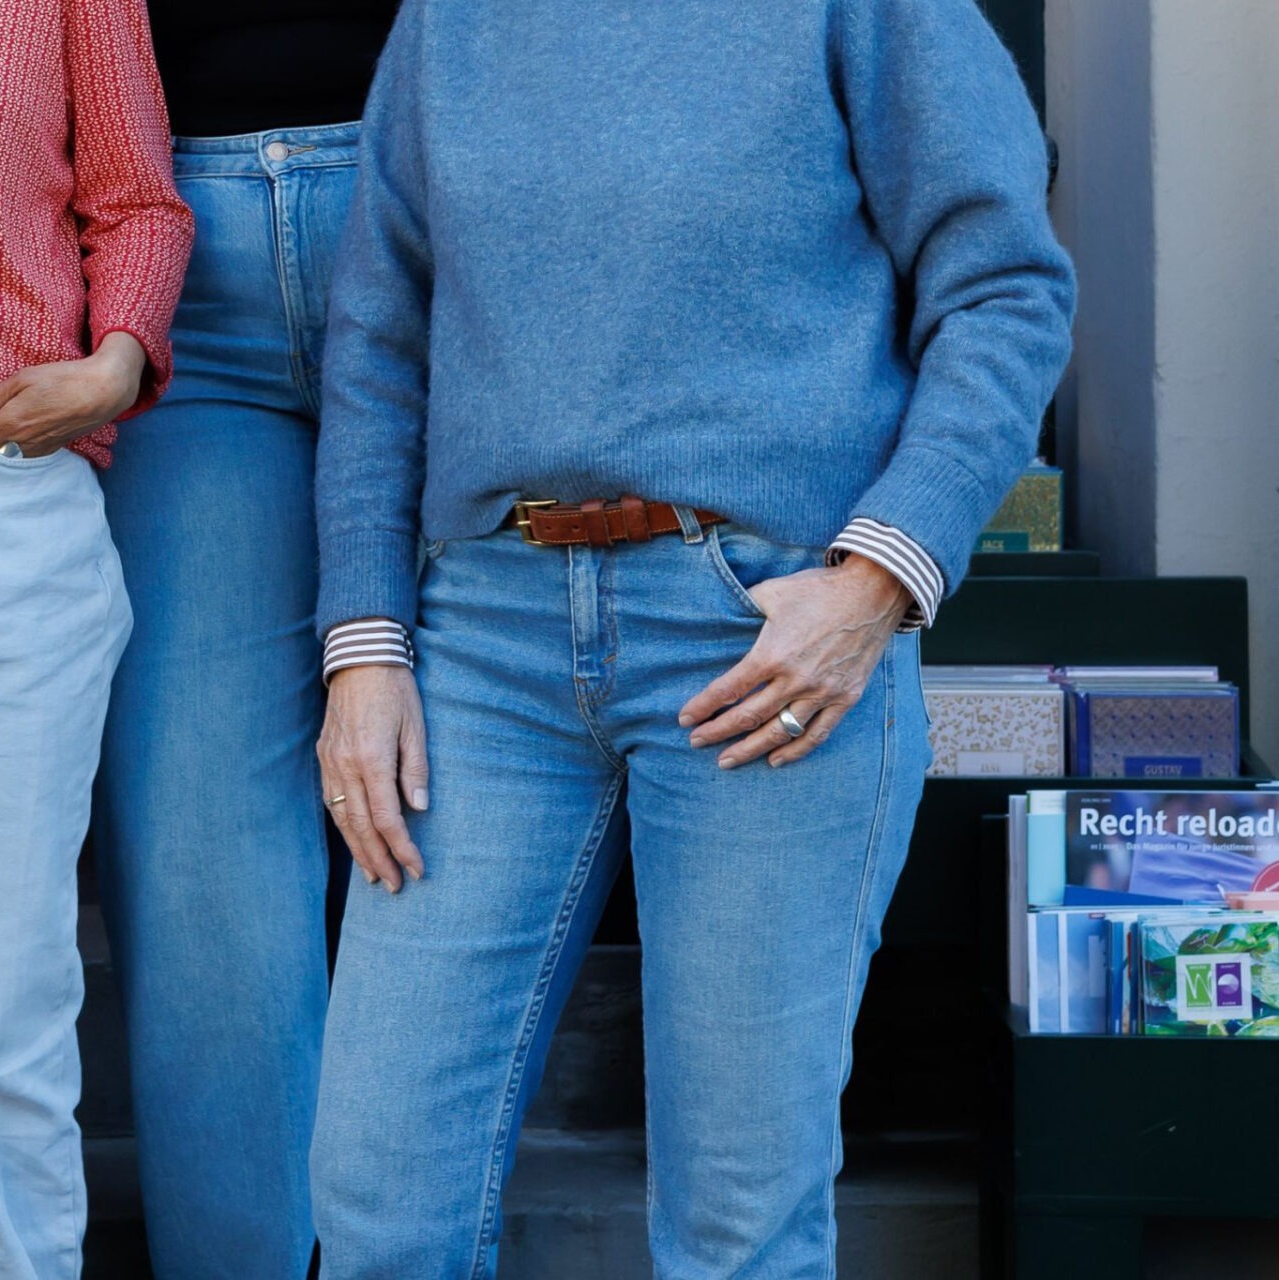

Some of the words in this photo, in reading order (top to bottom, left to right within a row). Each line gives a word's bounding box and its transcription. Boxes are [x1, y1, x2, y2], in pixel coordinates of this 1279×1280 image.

[1144, 764, 1183, 777] GUSTAV
[1079, 806, 1169, 837] Recht
[1176, 807, 1279, 837] reload
